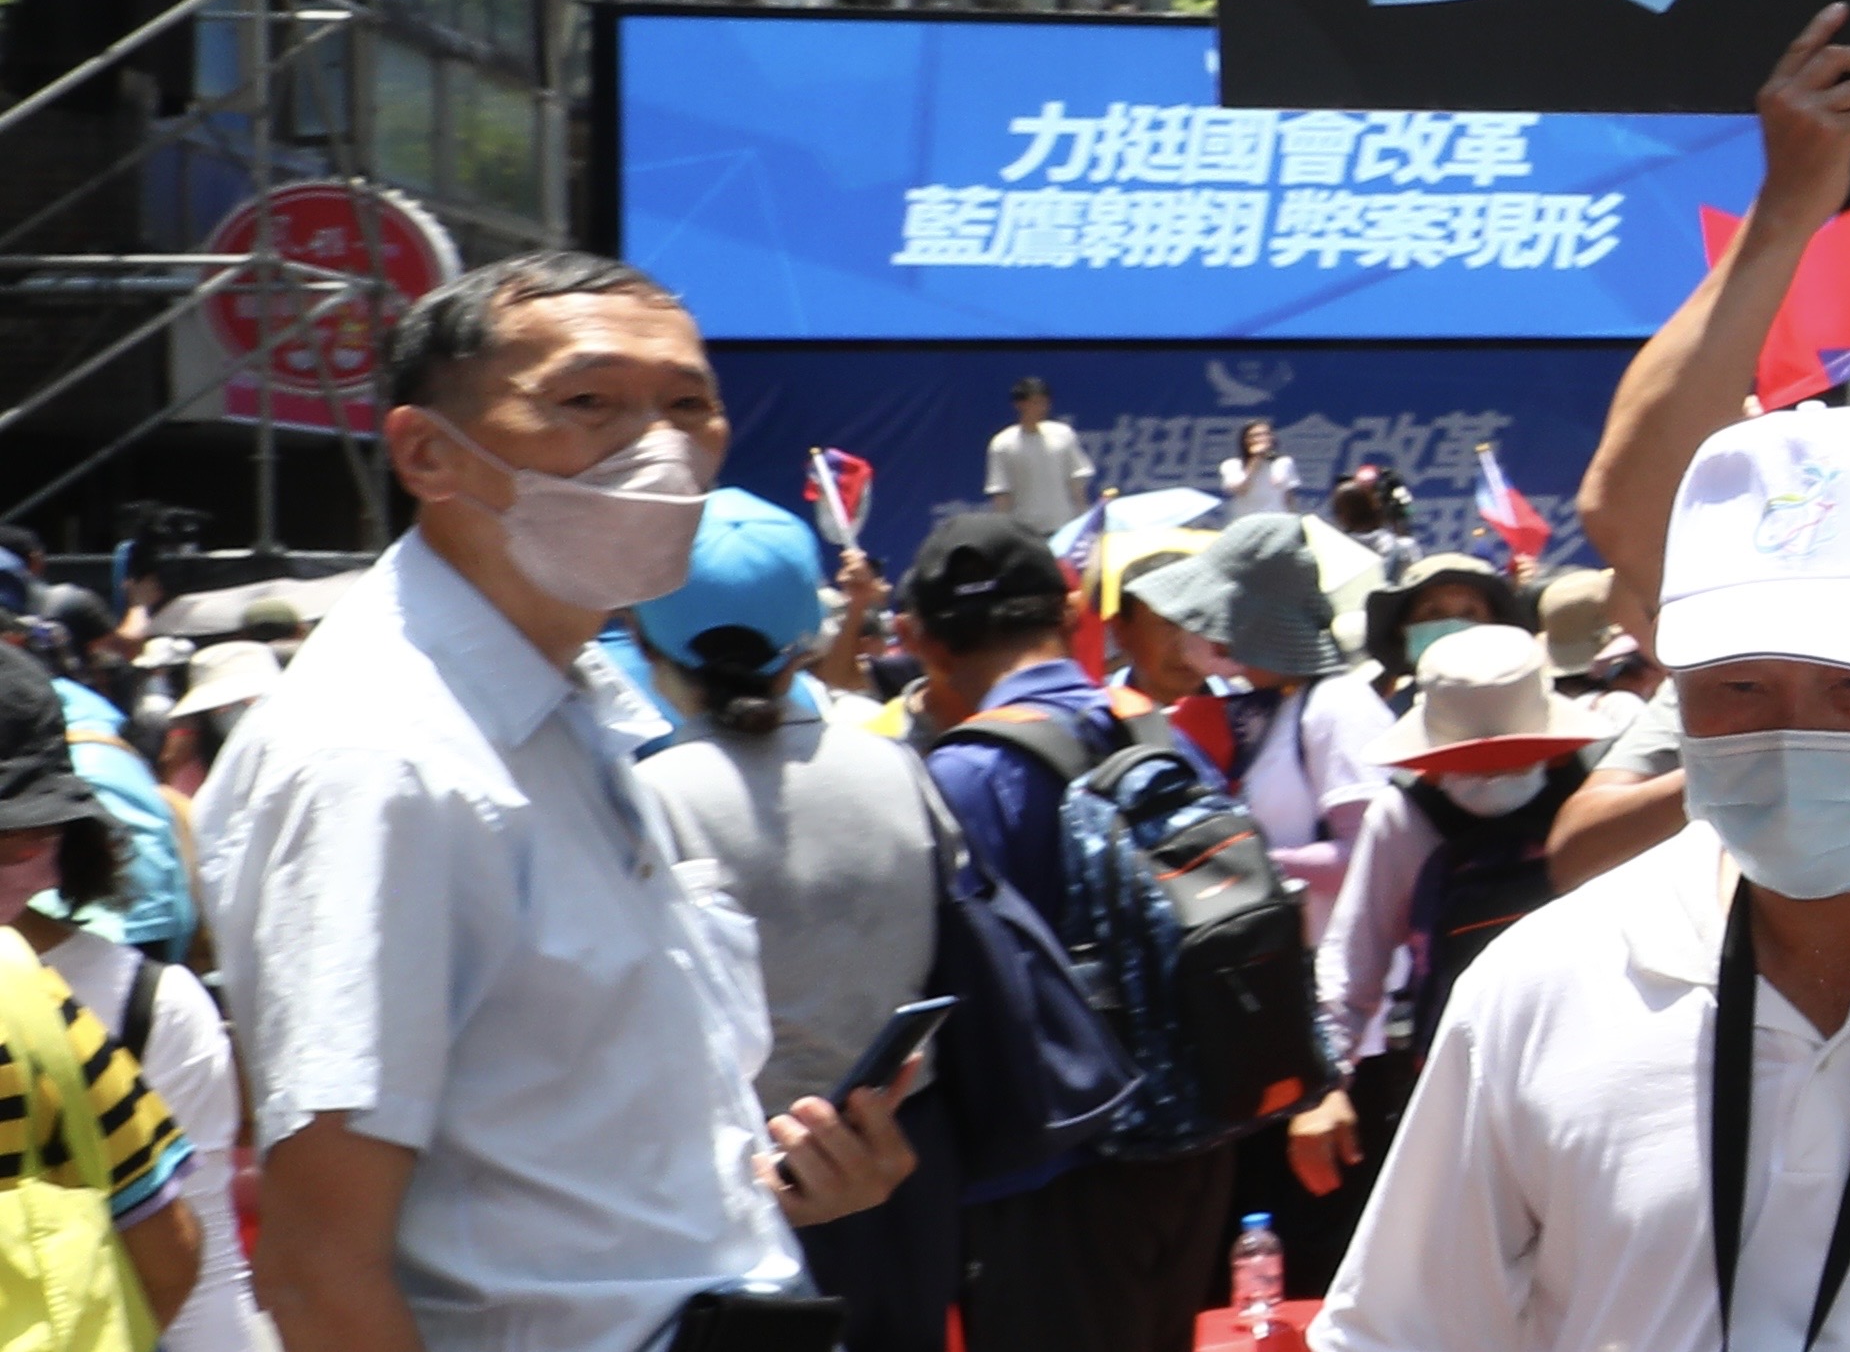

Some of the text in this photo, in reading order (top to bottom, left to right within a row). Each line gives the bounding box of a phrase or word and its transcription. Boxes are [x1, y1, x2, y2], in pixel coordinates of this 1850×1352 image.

[1001, 101, 1539, 184] 力挺國會改革
[890, 185, 1624, 270] 藍鷹翱翔 弊案現形
